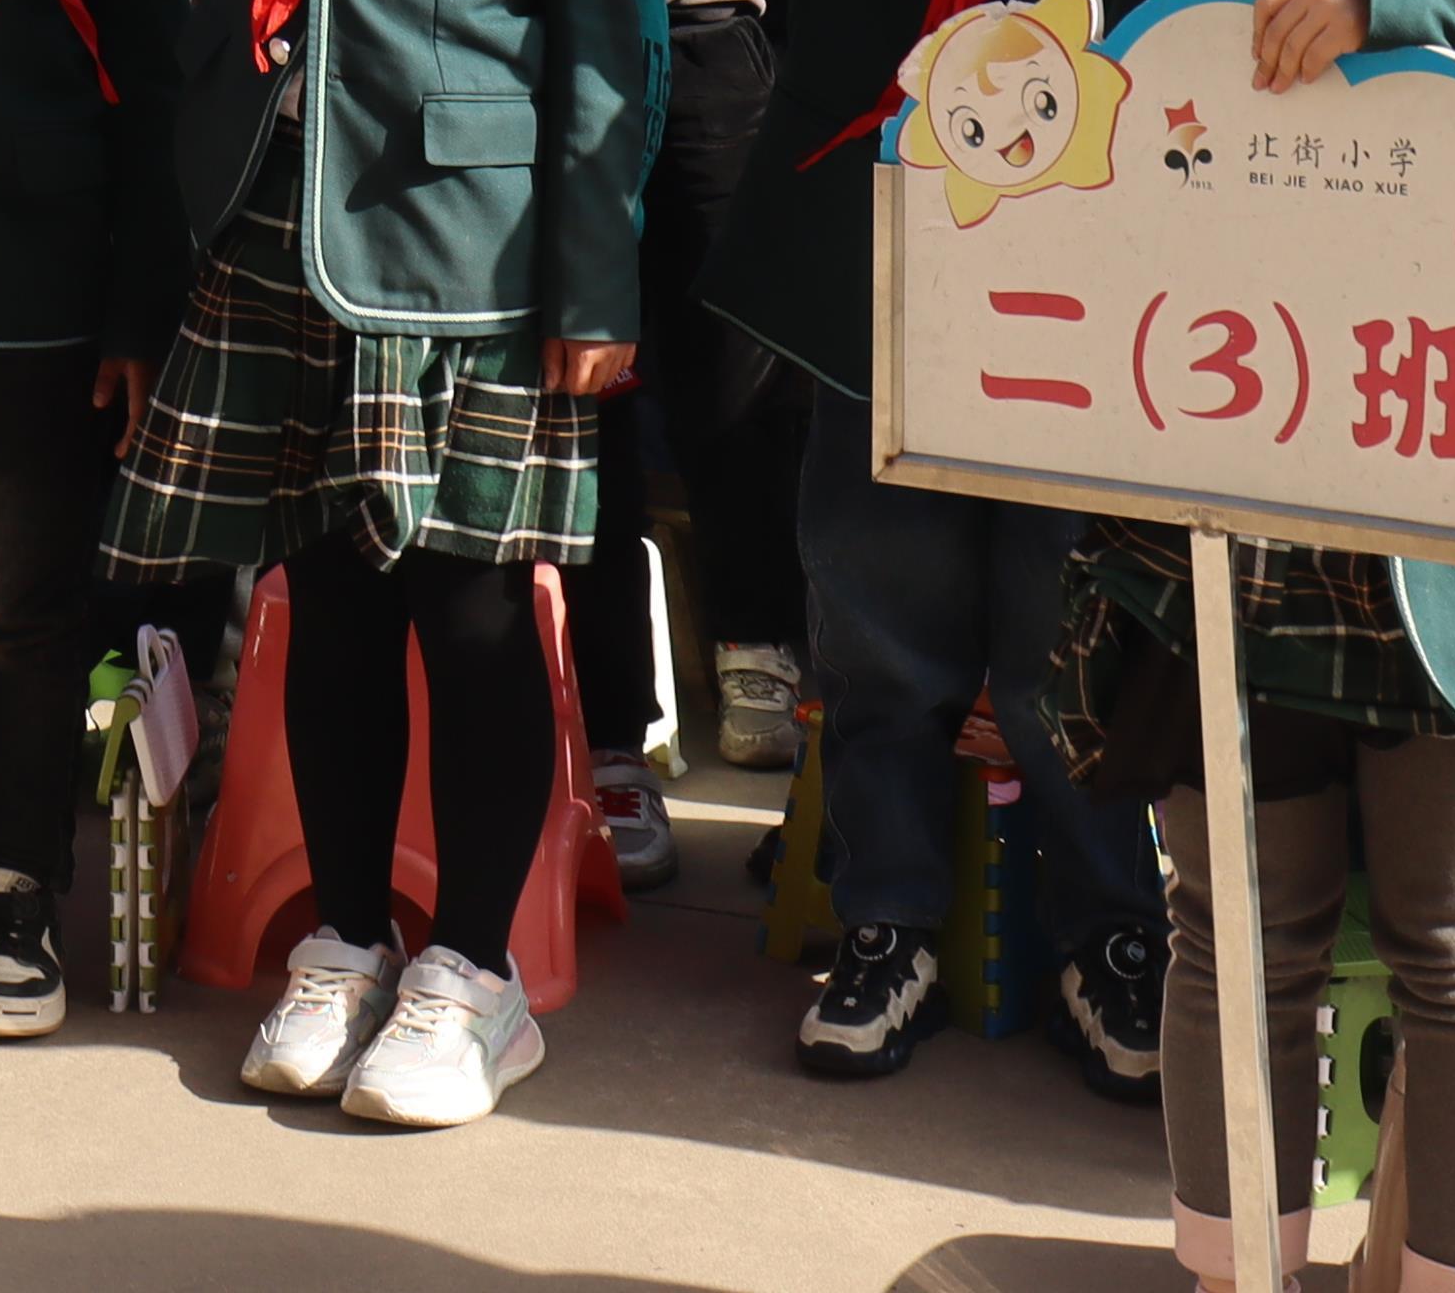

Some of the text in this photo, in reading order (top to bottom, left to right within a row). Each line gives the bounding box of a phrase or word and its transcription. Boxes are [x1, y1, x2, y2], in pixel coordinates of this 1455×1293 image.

[1247, 133, 1416, 177] 北街小学
[1249, 172, 1409, 197] BEI JIE XIAO XUE
